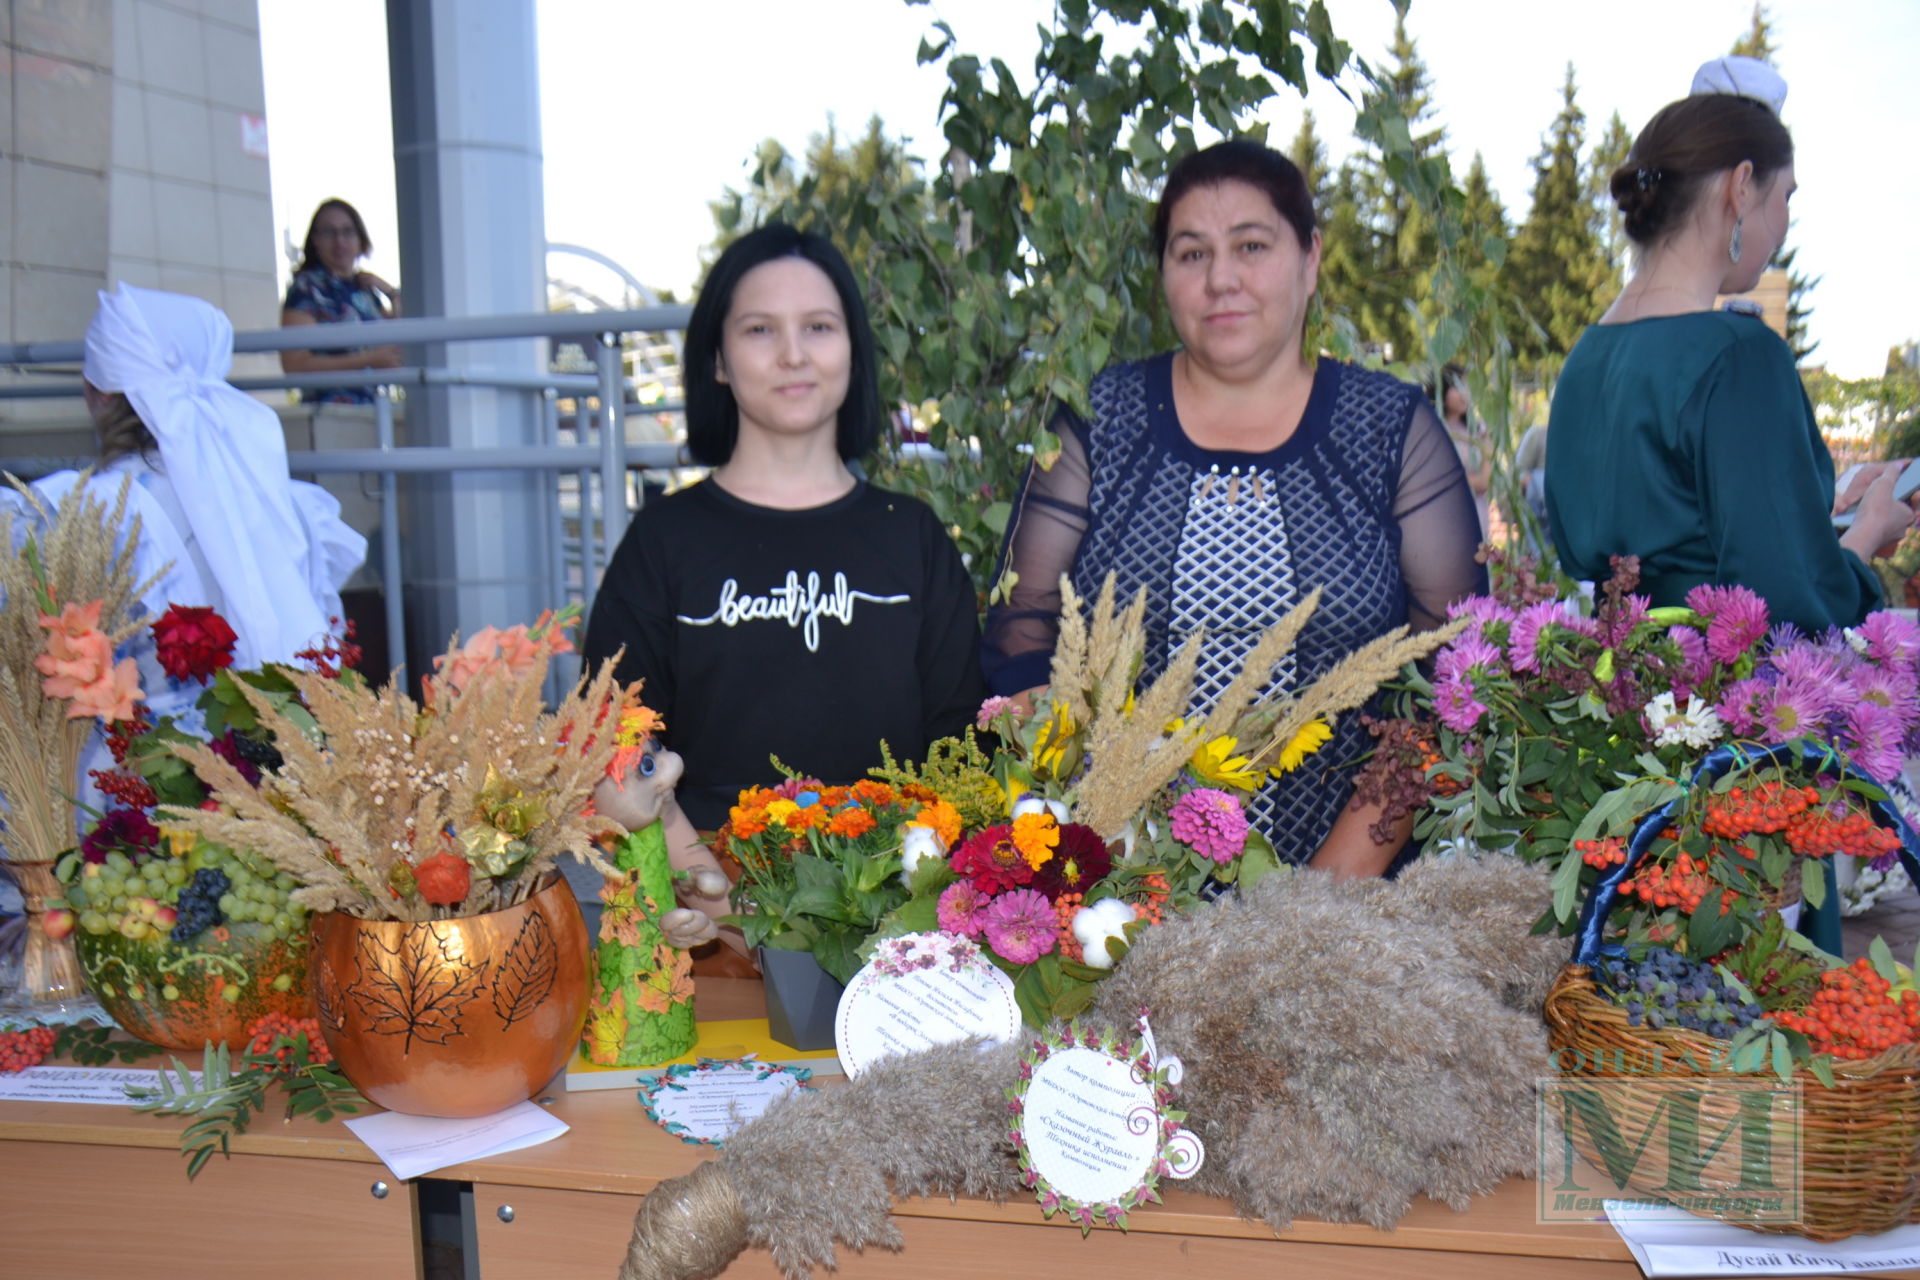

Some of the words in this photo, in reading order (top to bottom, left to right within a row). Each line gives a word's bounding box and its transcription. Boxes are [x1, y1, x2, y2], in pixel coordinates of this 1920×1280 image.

[677, 570, 911, 652] beautiful
[1040, 1115, 1090, 1144] «Сказочный
[1045, 1131, 1081, 1153] Техника
[1717, 1251, 1782, 1267] Дусай
